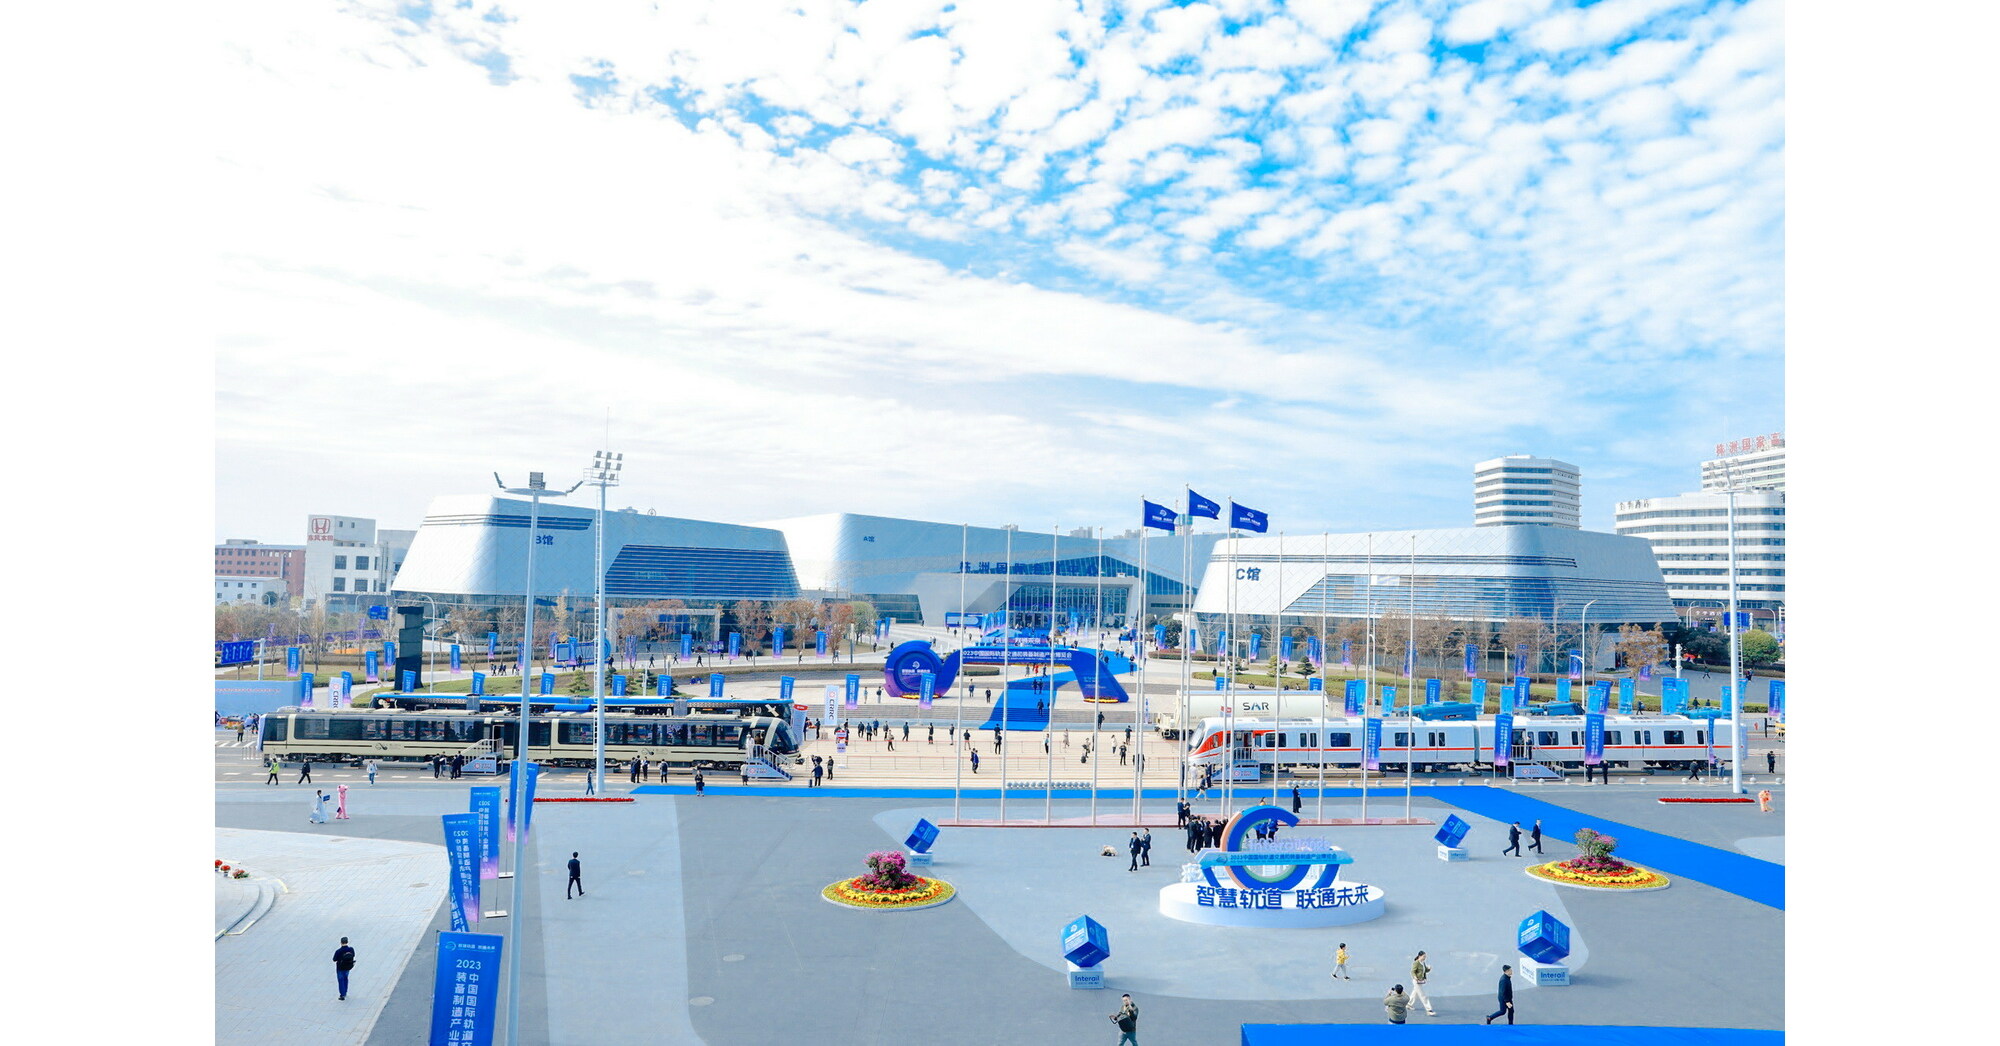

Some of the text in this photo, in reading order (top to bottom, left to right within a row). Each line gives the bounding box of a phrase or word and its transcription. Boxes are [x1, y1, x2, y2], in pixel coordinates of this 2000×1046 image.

[1236, 566, 1261, 581] C馆
[1242, 701, 1270, 711] SAR
[1196, 884, 1369, 910] 智慧轨道 联通未来
[456, 959, 482, 970] 2023
